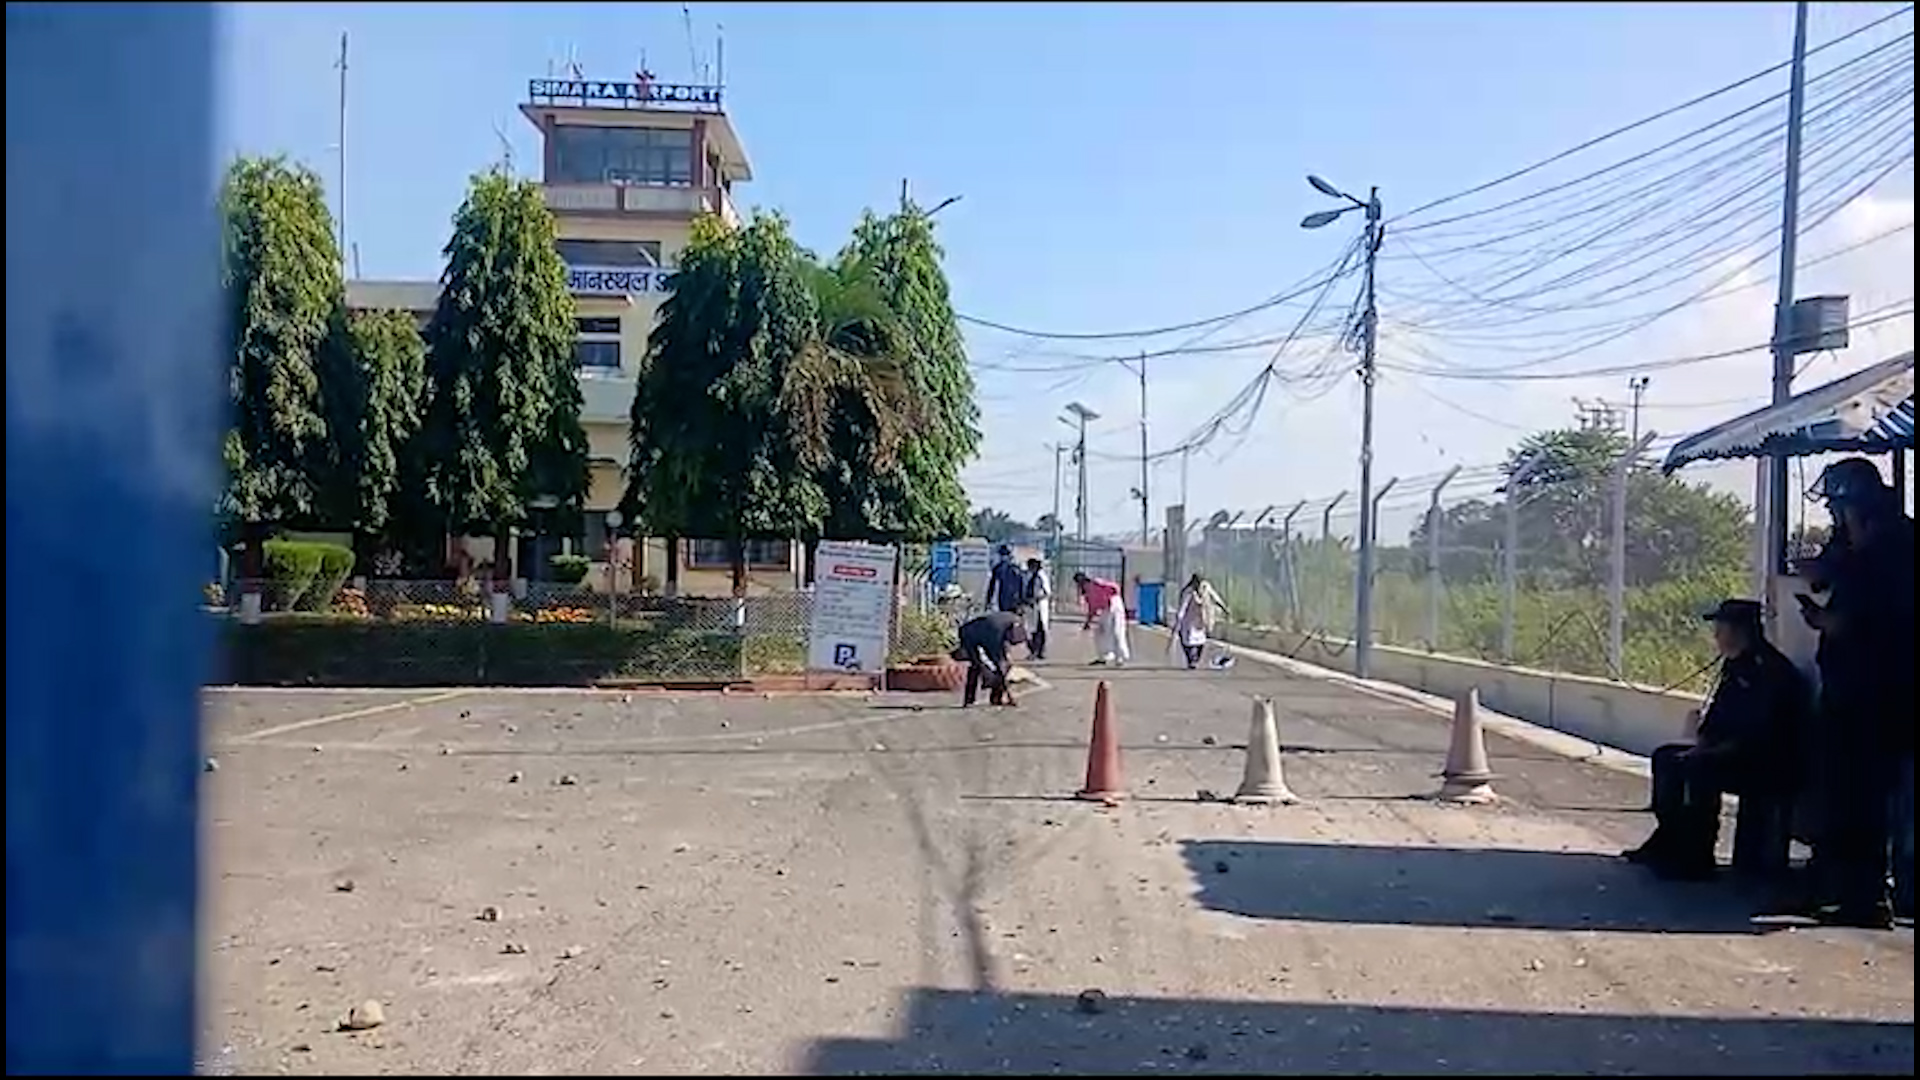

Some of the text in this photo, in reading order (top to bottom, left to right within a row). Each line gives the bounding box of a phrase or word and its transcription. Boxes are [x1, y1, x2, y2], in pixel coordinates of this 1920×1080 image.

[531, 80, 719, 102] SIMARA ARPORT
[568, 271, 649, 291] मानस्थल
